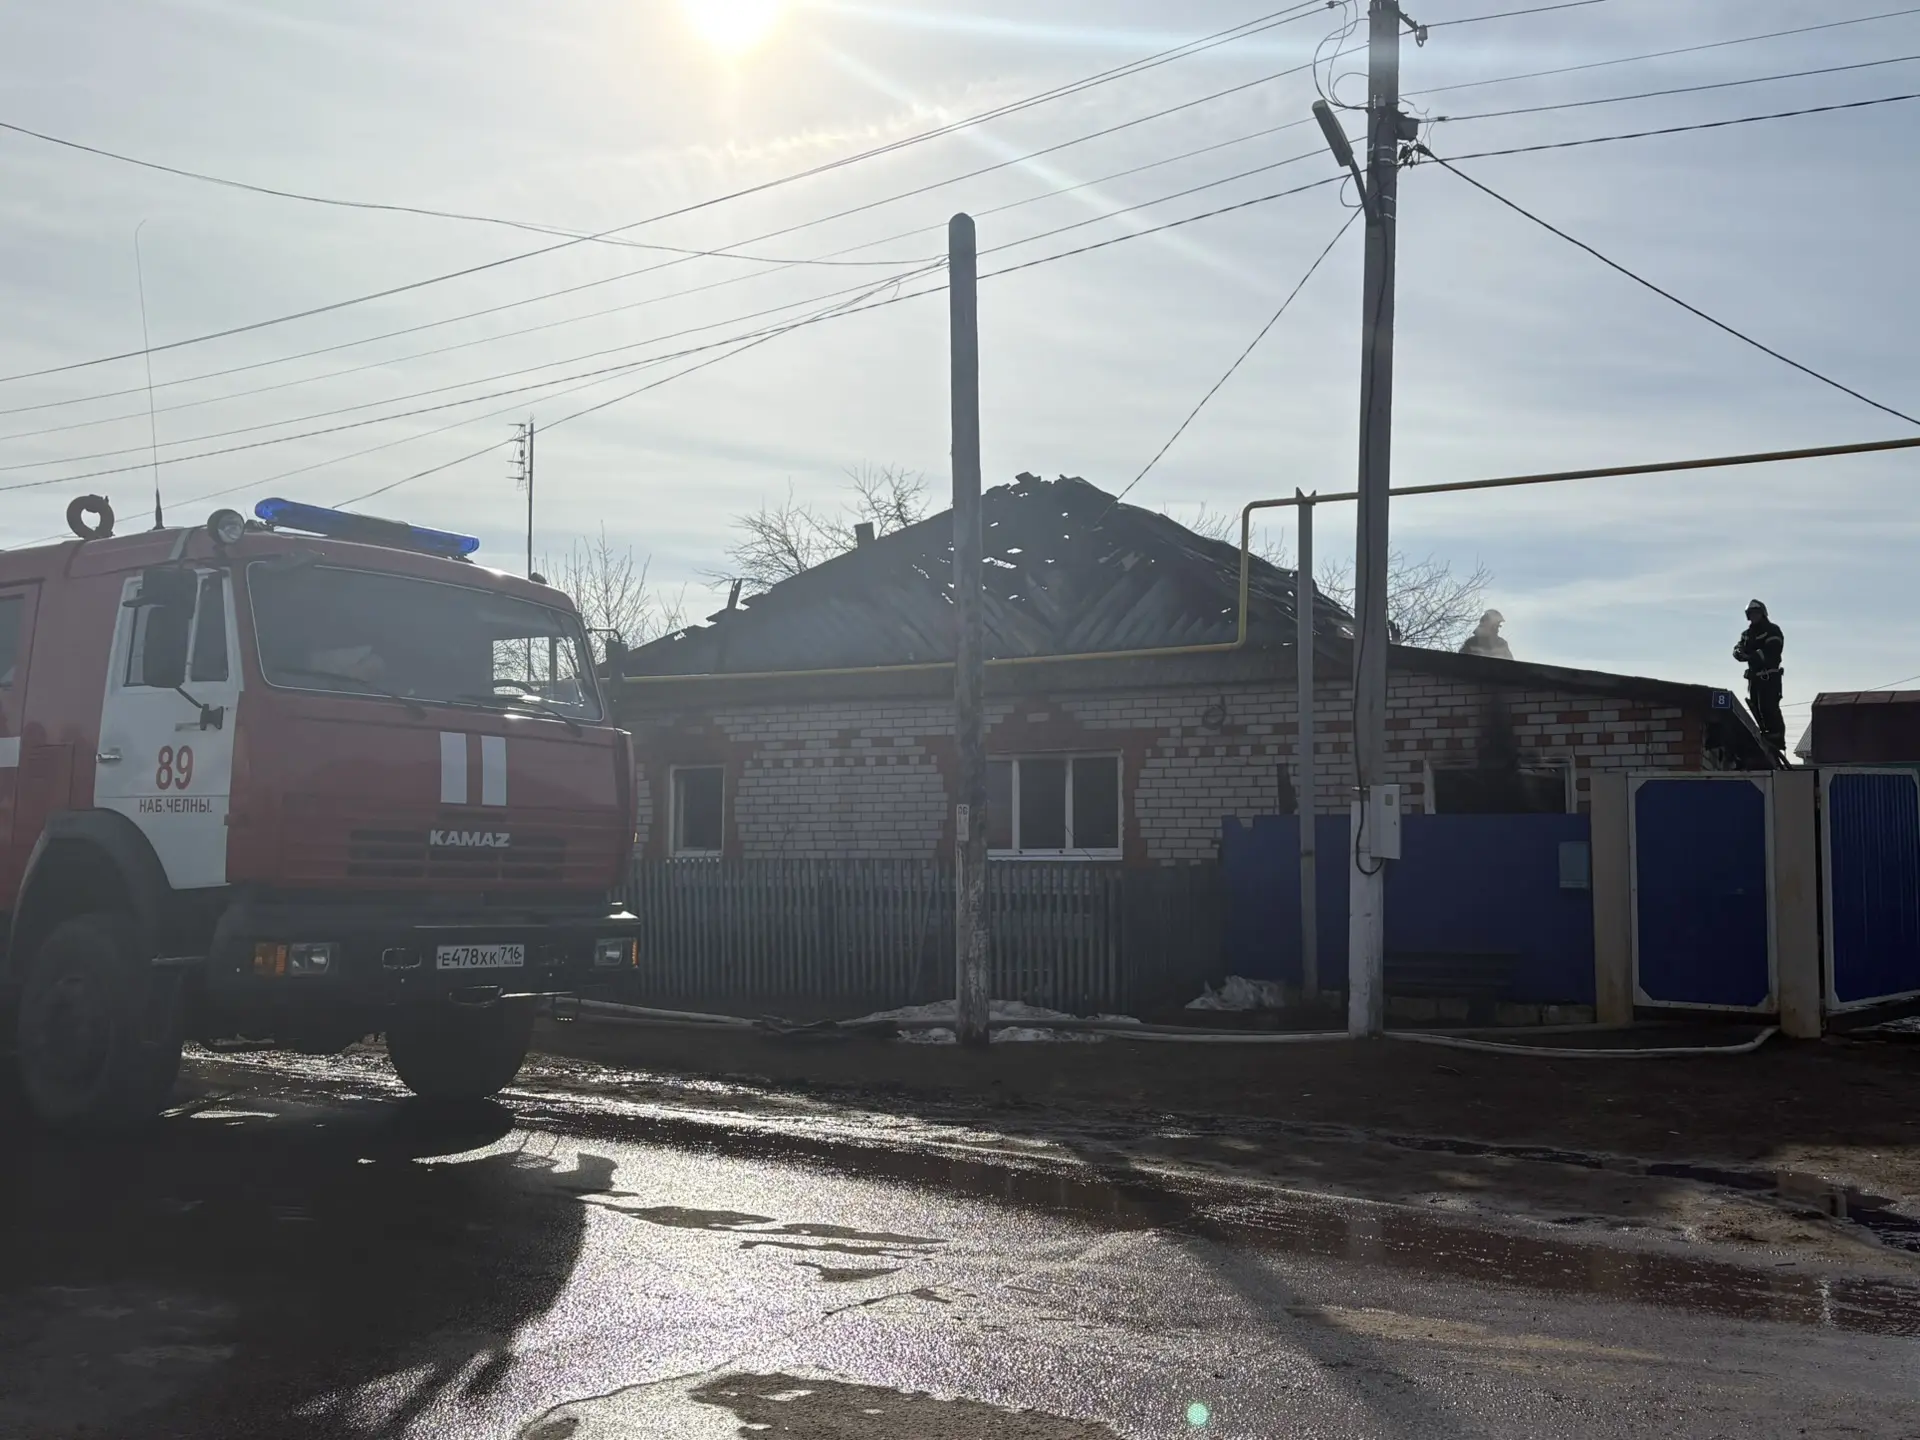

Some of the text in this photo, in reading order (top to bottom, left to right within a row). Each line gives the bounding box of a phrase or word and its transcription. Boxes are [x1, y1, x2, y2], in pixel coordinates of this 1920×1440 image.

[1718, 694, 1725, 705] 8
[155, 745, 194, 790] 89
[429, 829, 511, 848] KAMAZ
